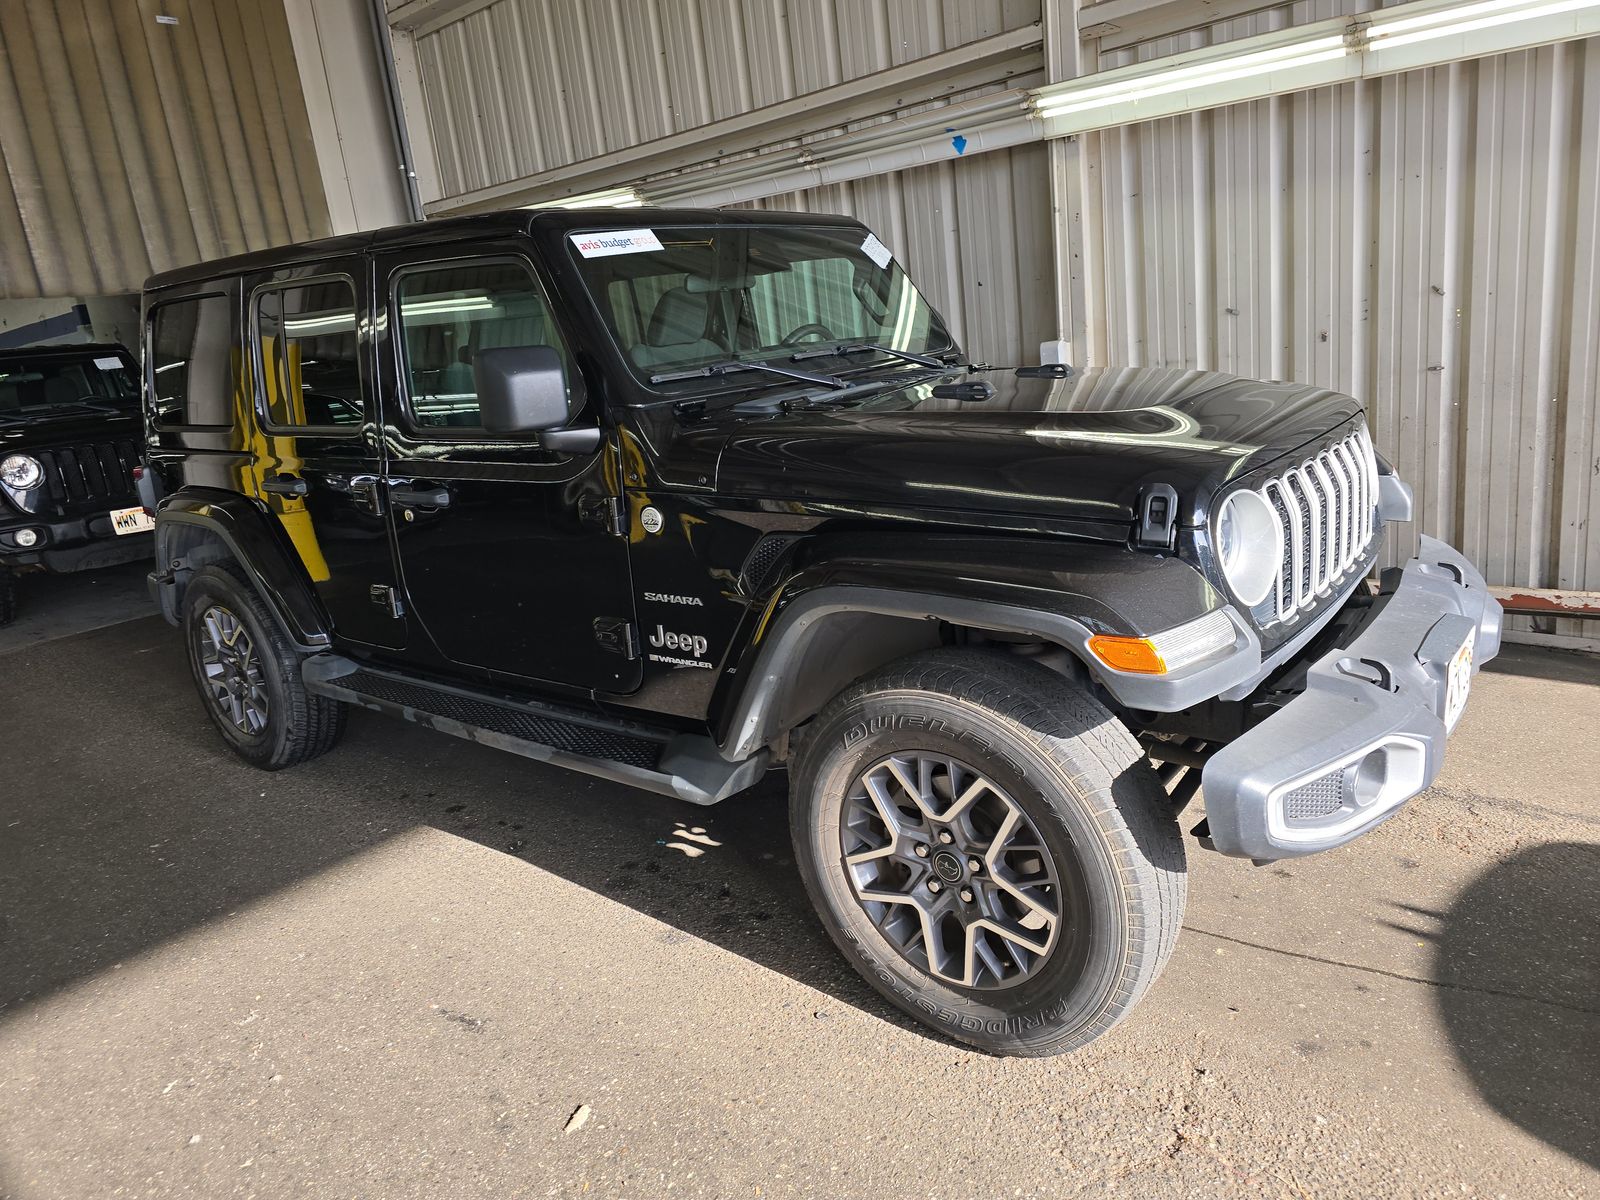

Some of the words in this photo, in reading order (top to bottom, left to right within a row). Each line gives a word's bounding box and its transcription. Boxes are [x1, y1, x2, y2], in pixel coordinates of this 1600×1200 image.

[644, 592, 704, 607] SAHARA
[649, 624, 708, 657] Jeep
[657, 655, 713, 669] WRANGLER
